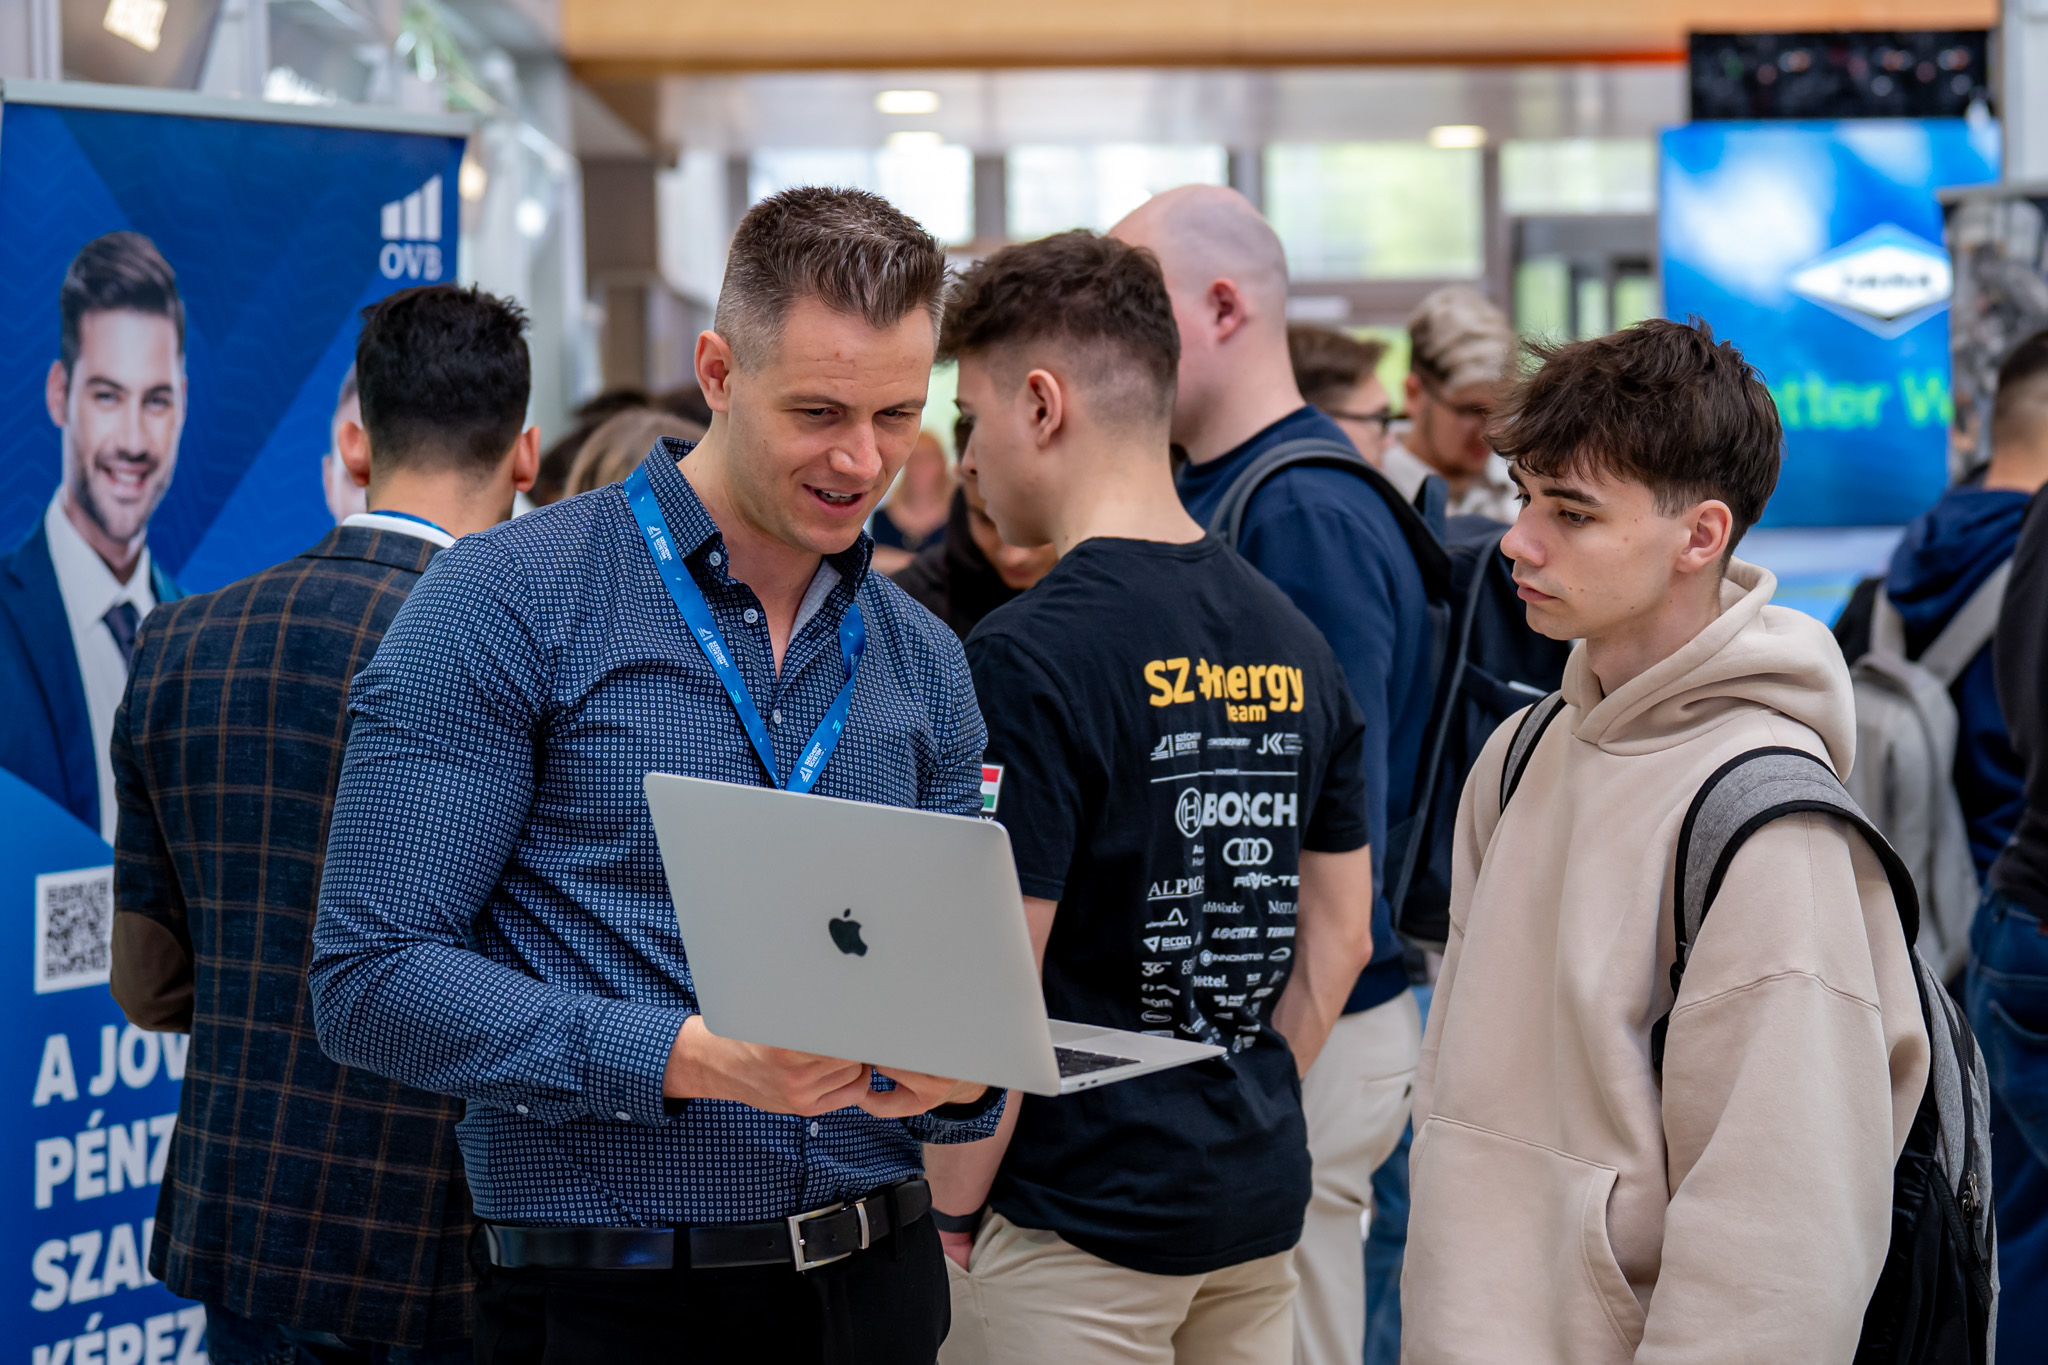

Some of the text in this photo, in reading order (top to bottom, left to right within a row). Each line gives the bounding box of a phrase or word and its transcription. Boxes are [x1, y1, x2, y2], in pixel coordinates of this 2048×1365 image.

[379, 241, 443, 281] OVB
[1779, 375, 1890, 432] tter
[1201, 791, 1298, 827] BOSCH
[32, 1033, 79, 1107] A
[34, 1108, 180, 1210] PÉNZ
